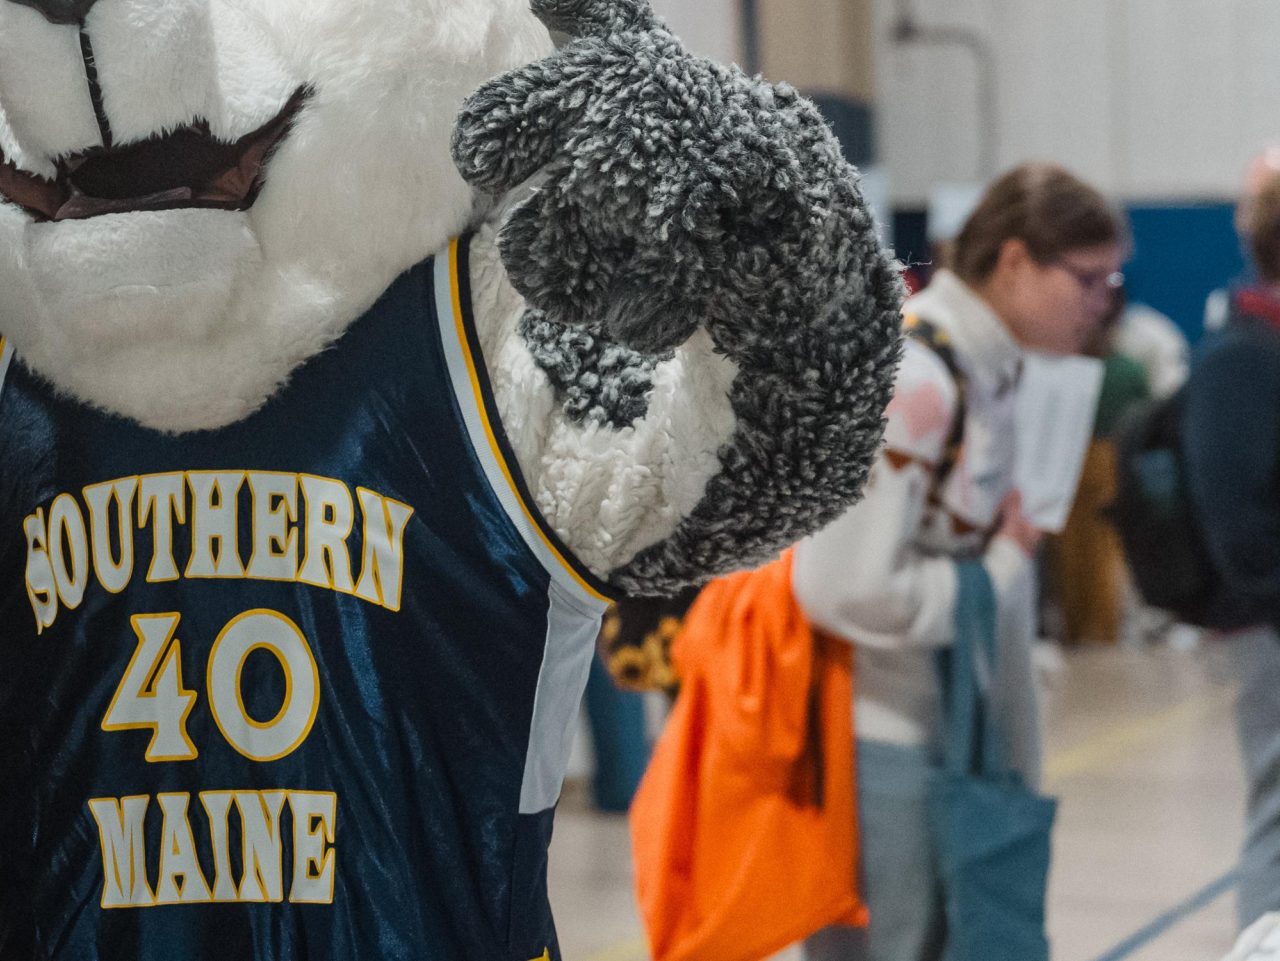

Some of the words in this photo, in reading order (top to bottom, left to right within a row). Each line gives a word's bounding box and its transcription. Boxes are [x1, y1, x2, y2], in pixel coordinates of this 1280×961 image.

[23, 470, 414, 635] SOUTHERN
[101, 608, 321, 762] 40
[88, 789, 337, 908] MAINE
